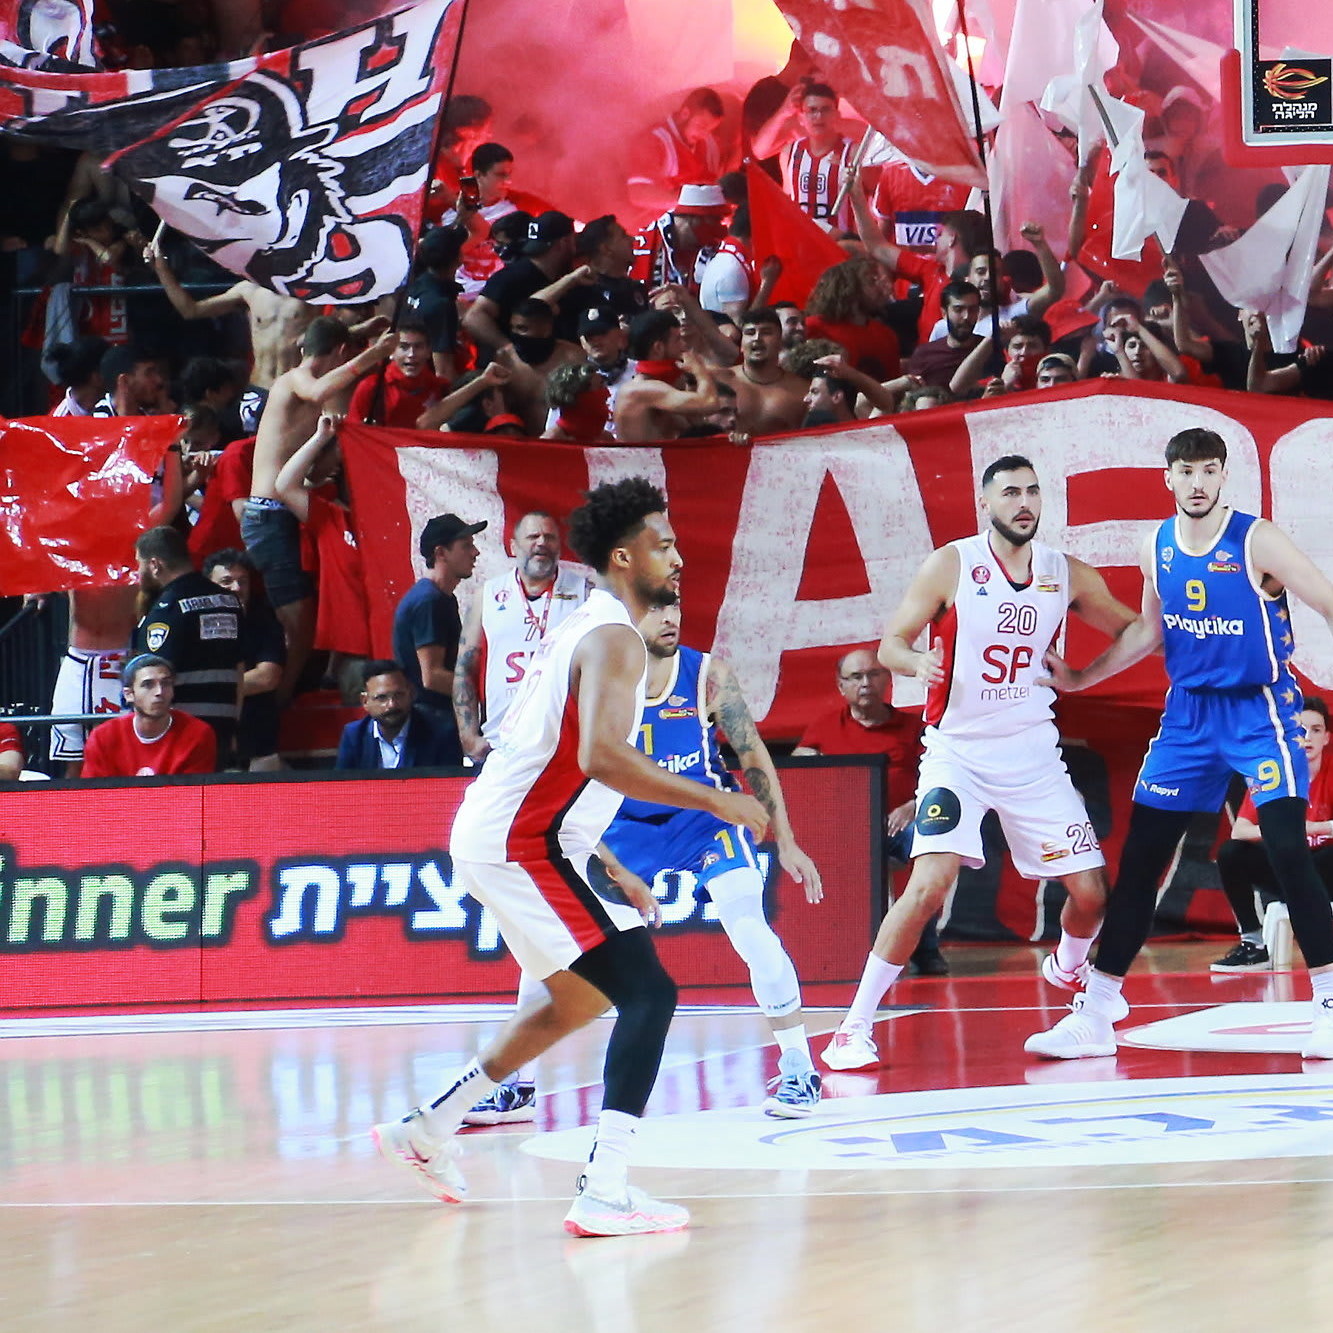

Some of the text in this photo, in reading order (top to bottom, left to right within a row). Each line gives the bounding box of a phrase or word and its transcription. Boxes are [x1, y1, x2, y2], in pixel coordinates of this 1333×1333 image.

[1271, 101, 1318, 112] מנהלת
[1275, 108, 1315, 120] הליגה
[905, 226, 938, 244] VIS
[1185, 578, 1207, 612] 9
[997, 602, 1038, 636] 20
[1163, 613, 1244, 639] Playtika
[981, 644, 1034, 684] SP
[1149, 783, 1181, 797] Rapyd
[1257, 759, 1282, 791] 9
[713, 828, 737, 859] 1
[0, 854, 250, 945] nner
